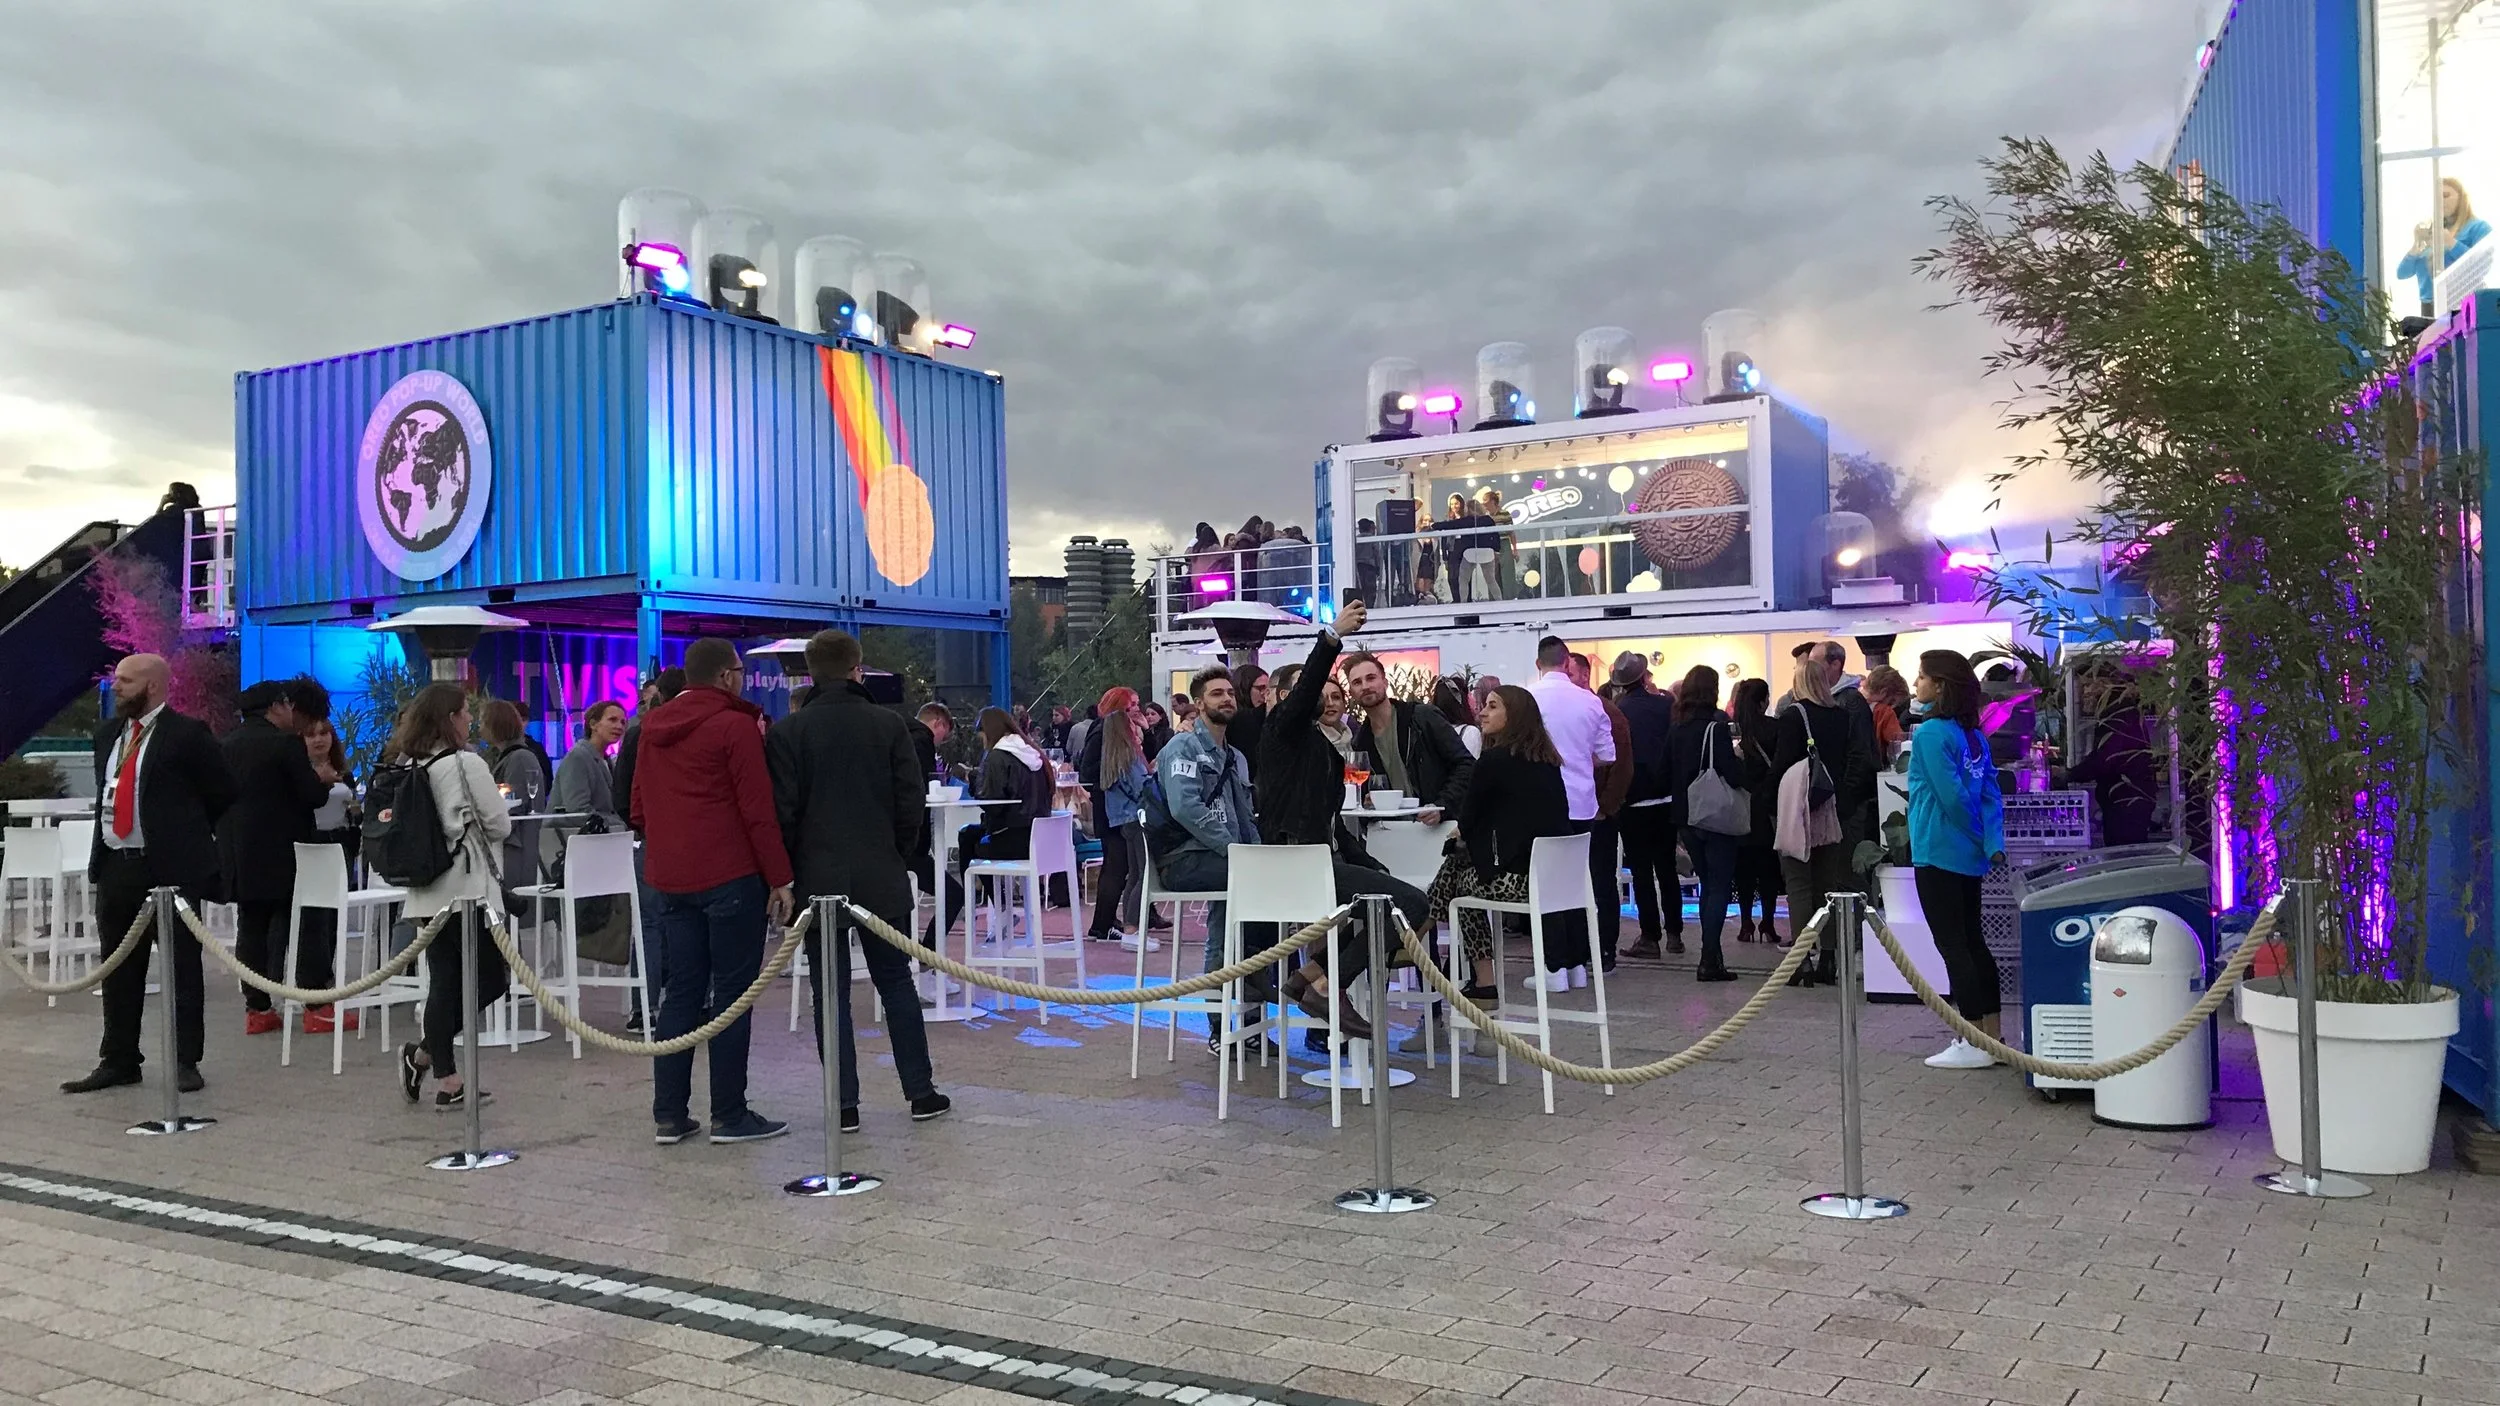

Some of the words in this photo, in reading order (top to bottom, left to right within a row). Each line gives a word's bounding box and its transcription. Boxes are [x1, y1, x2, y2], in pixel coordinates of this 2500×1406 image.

[362, 403, 390, 461] OREO
[390, 374, 444, 407] POP-UP
[445, 380, 486, 445] WORLD
[1502, 487, 1581, 525] OREO
[512, 661, 638, 712] TWIS
